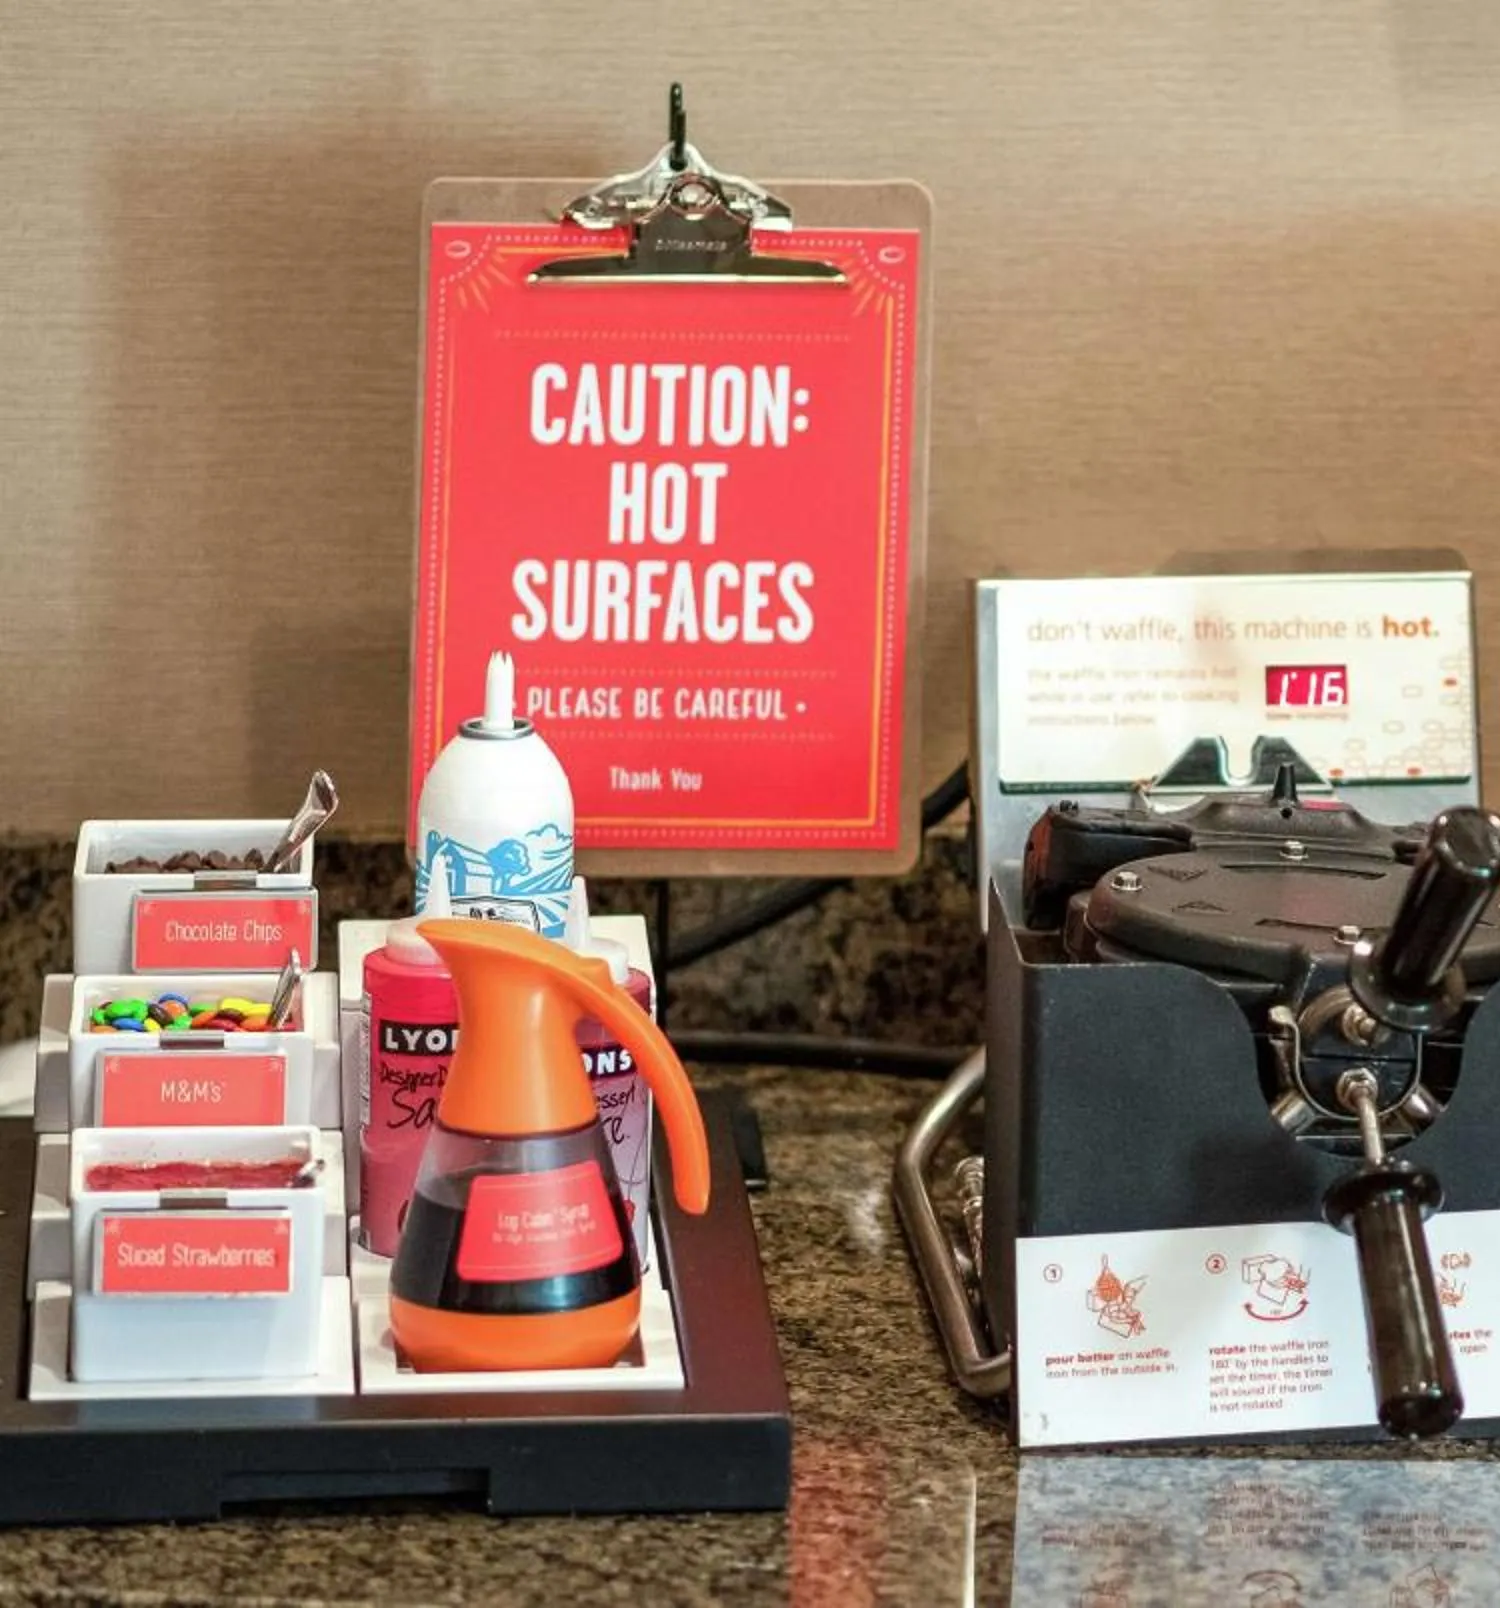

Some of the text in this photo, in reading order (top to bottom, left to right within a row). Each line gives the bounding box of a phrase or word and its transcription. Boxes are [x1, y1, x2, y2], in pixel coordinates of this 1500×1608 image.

[530, 362, 810, 448] CAUTION:
[609, 462, 728, 544] HOT
[511, 559, 814, 643] SURFACES
[1027, 615, 1439, 644] don't waffle, this machine is hot.
[527, 686, 787, 720] PLEASE BE CAREFUL
[609, 766, 703, 791] Thank You
[165, 919, 282, 945] Chocolate Chips
[385, 1027, 460, 1052] LYO
[160, 1080, 222, 1103] M&M's
[117, 1242, 275, 1268] Sliced Strawberries
[1045, 1355, 1075, 1367] pour
[1209, 1345, 1246, 1356] rotate
